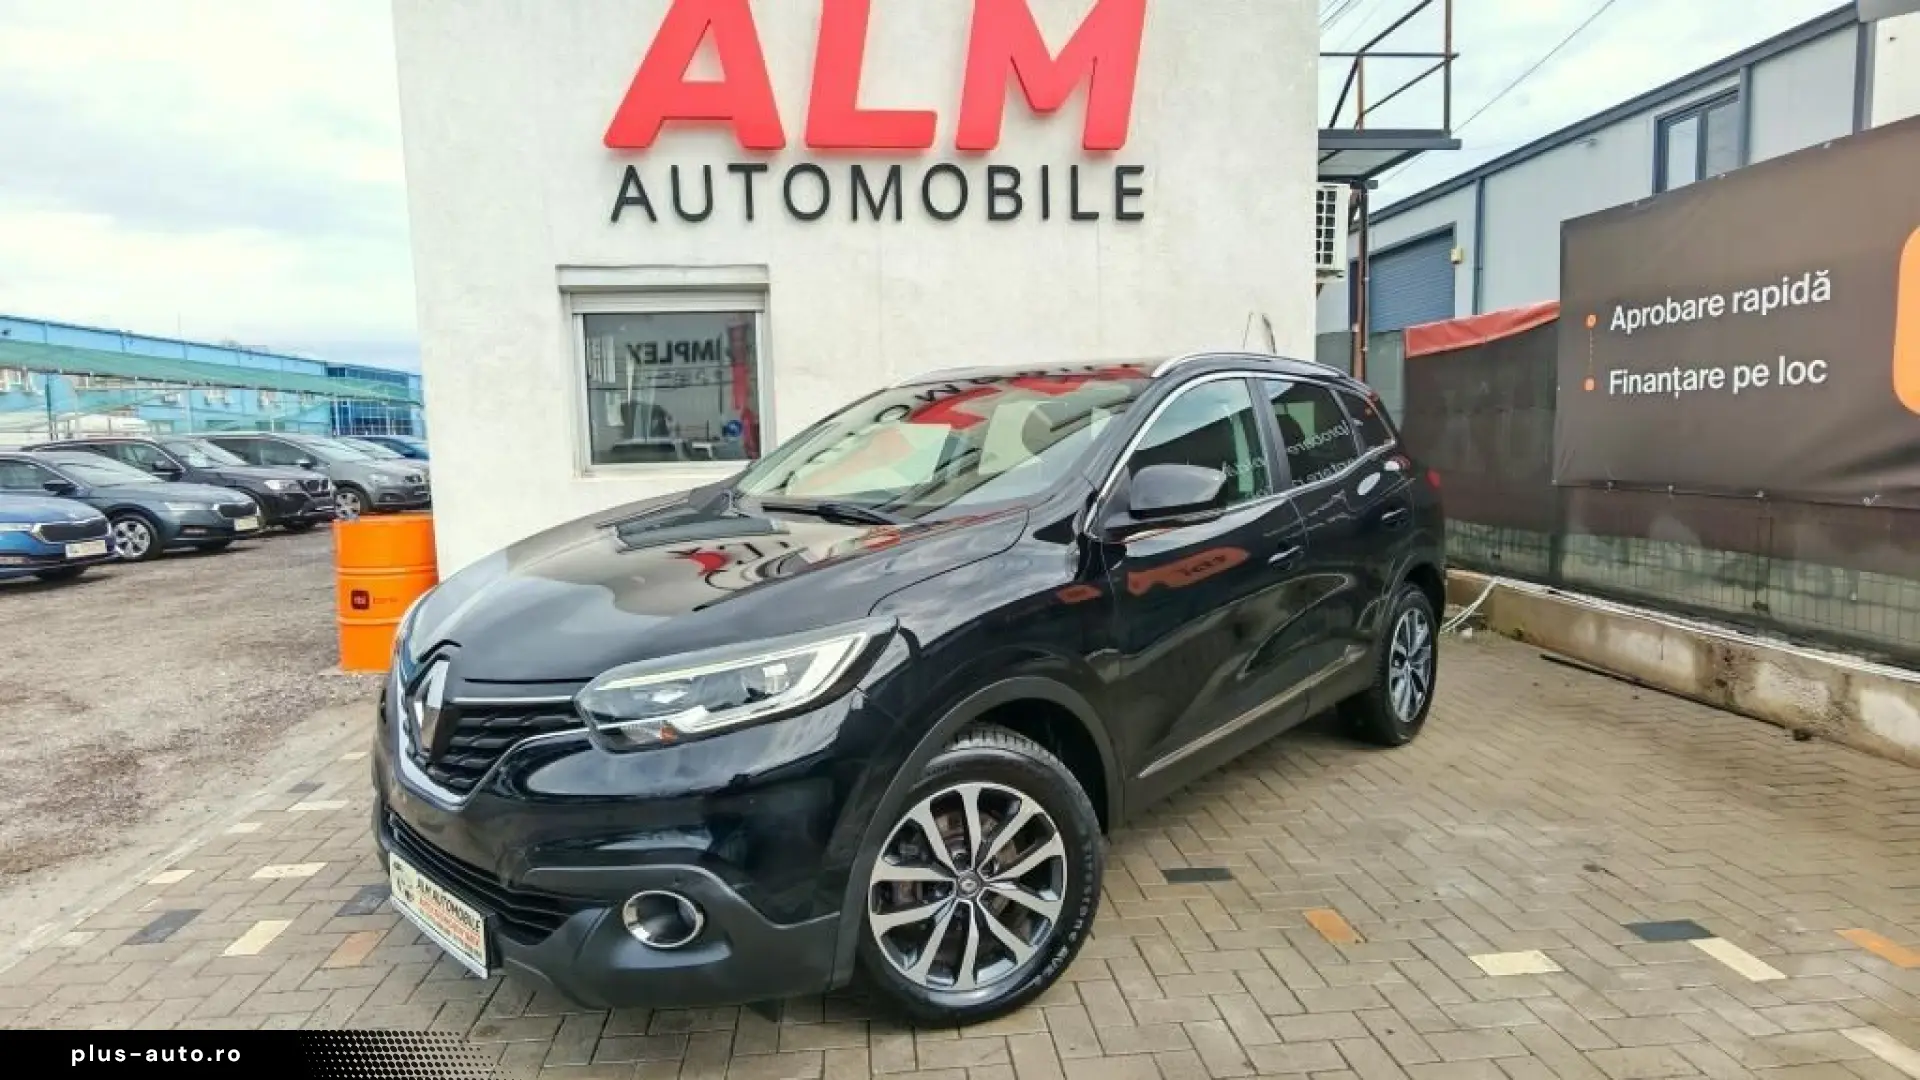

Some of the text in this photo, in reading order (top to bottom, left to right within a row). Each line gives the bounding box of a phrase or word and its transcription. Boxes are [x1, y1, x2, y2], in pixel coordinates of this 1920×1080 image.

[604, 0, 1148, 151] ALM
[610, 162, 1146, 223] AUTOMOBILE
[1610, 268, 1832, 334] Aprobare rapidă
[1609, 355, 1829, 399] Finanțare pe loc
